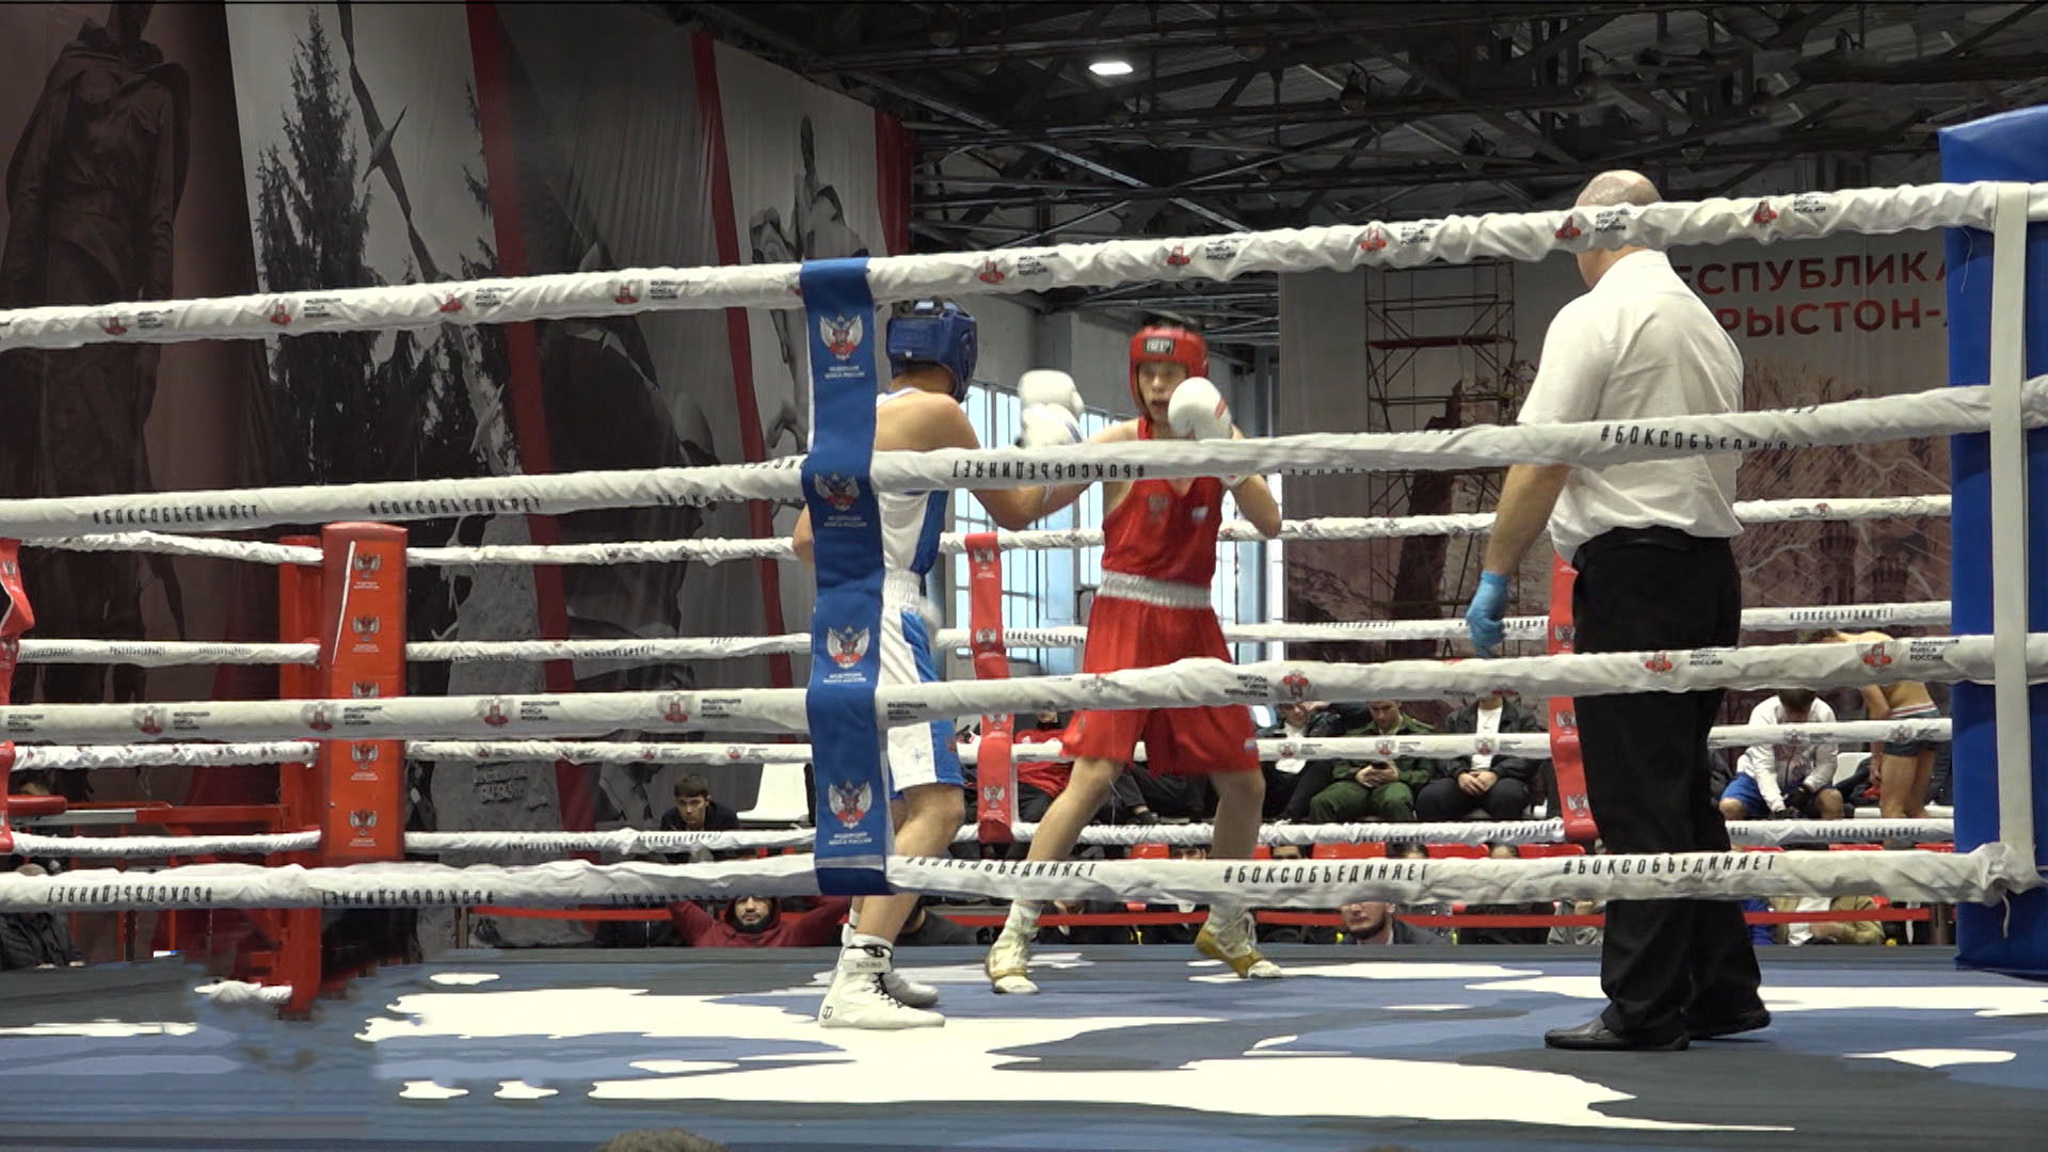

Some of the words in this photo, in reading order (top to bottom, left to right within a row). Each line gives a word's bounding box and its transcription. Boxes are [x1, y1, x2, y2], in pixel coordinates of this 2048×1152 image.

[1715, 298, 1947, 337] РЫСТОН-
[1223, 863, 1428, 884] #БОКСОБЪЕДИНЯЕТ
[1562, 855, 1776, 875] #БОКСОБЪЕДИНЯЕТ
